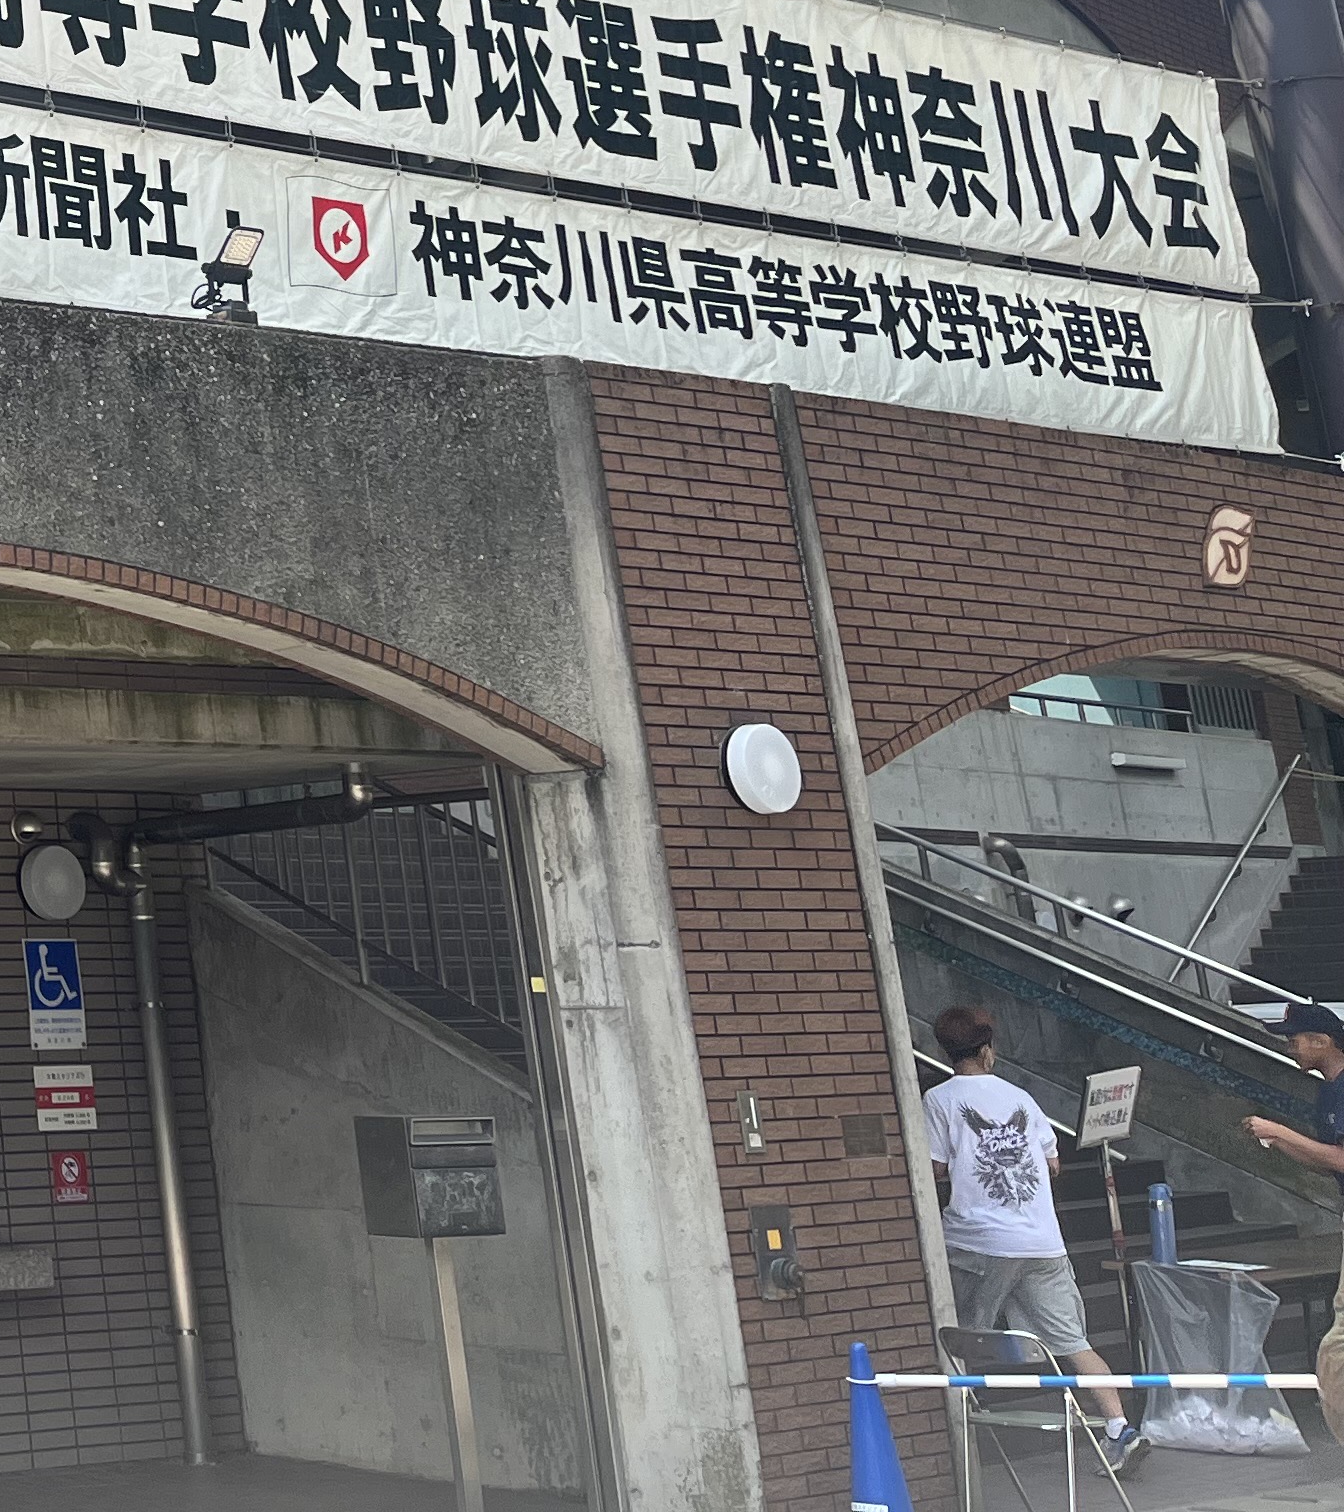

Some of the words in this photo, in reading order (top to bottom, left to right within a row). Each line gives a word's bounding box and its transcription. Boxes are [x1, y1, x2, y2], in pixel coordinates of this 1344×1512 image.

[410, 199, 1163, 393] 神奈川県高等学校野球連盟
